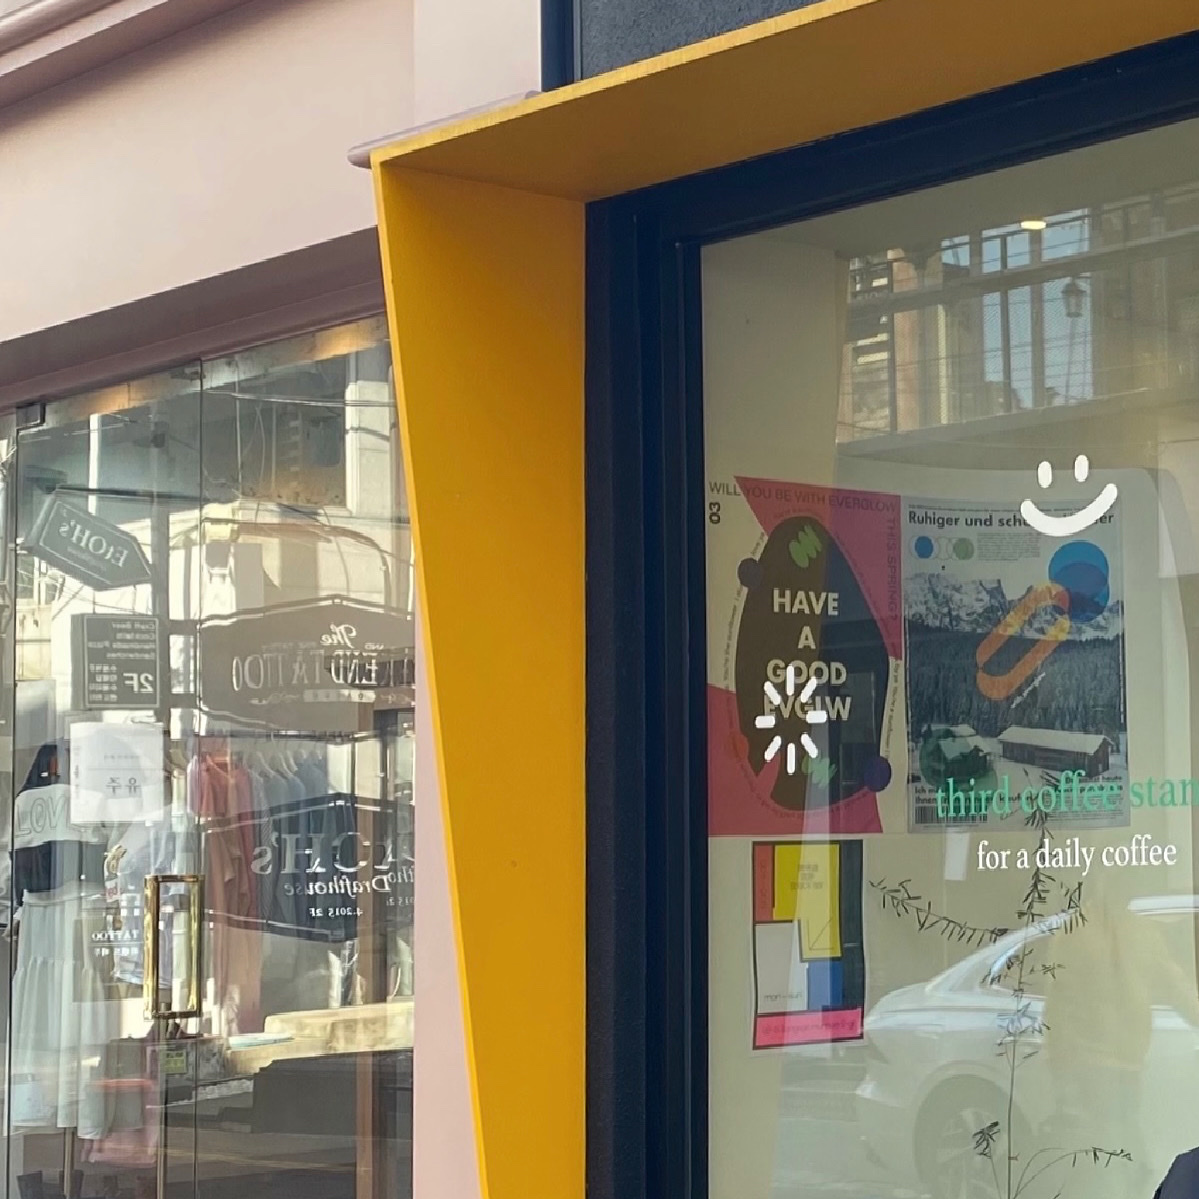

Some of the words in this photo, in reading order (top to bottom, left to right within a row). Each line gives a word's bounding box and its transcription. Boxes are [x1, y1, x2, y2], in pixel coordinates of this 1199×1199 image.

[708, 481, 742, 497] WILL
[746, 486, 773, 499] YOU
[775, 488, 789, 501] BE
[794, 489, 826, 505] WITH
[908, 510, 960, 529] Ruhiger
[964, 511, 993, 527] und
[772, 587, 840, 616] HAVE
[797, 625, 816, 650] A
[766, 659, 847, 685] GOOD
[936, 776, 1011, 818] third
[1020, 768, 1122, 815] coffee
[976, 840, 1011, 871] for
[1016, 848, 1030, 870] a
[1035, 838, 1096, 877] daily
[1101, 834, 1178, 868] coffee
